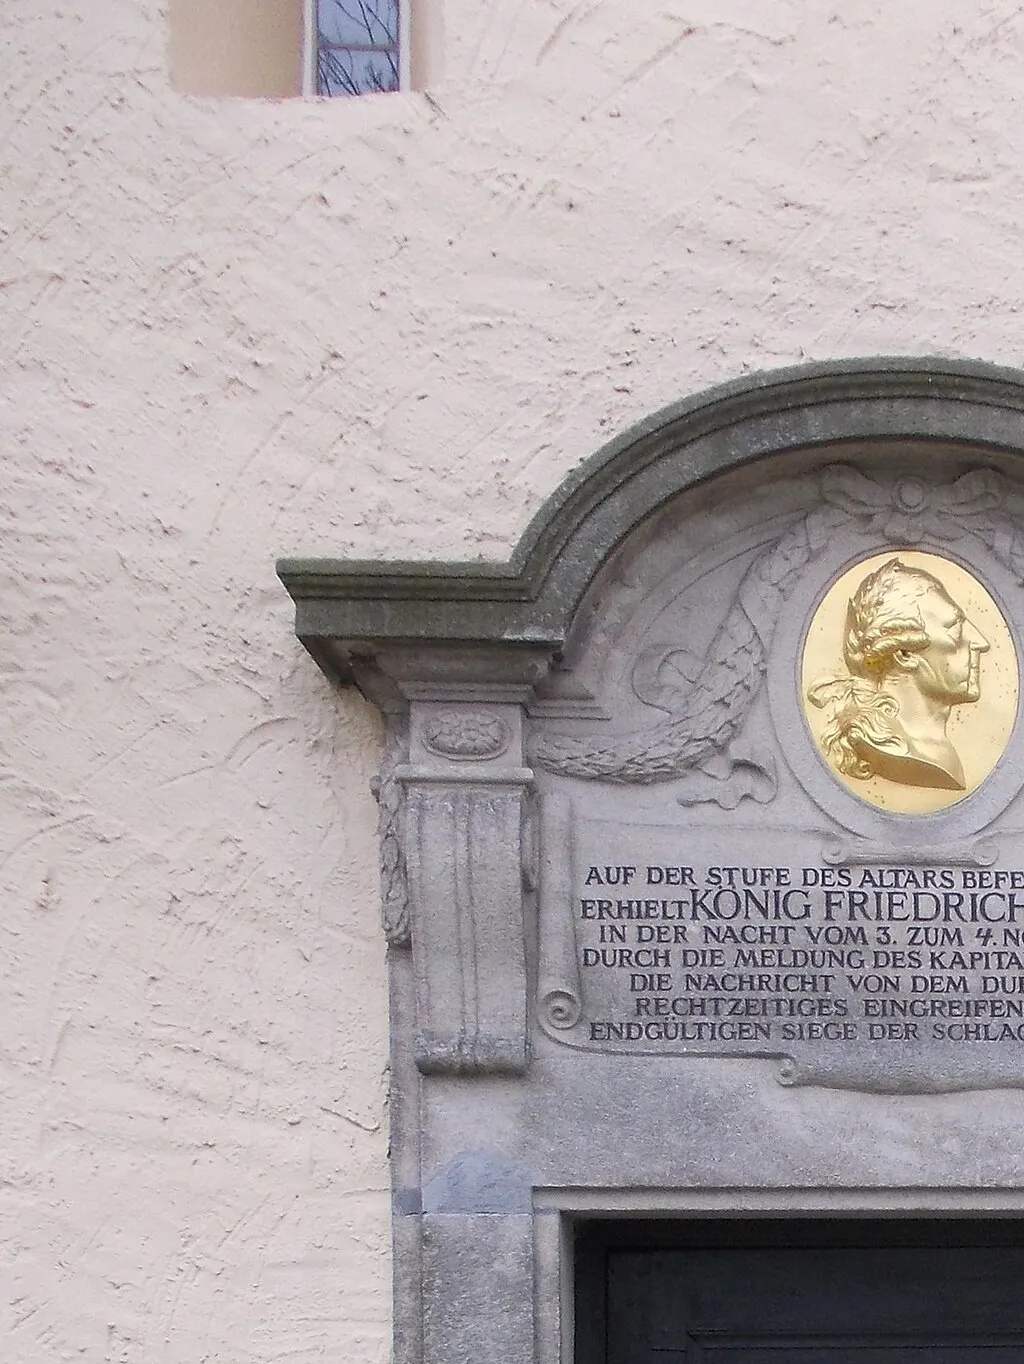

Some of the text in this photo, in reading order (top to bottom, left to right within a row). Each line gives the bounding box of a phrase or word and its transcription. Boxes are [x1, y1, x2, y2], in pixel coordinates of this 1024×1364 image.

[585, 866, 636, 885] AUF
[646, 867, 696, 886] DER
[705, 867, 790, 886] STUFE
[802, 868, 851, 887] DES
[858, 868, 954, 889] ALTARS
[581, 900, 689, 919] ERHIELT
[689, 884, 811, 920] KÖNIG
[599, 925, 627, 943] IN
[636, 926, 689, 943] DER
[703, 926, 793, 945] NACHT
[805, 927, 867, 945] VOM
[876, 927, 897, 945] 3.
[907, 927, 963, 946] ZUM
[975, 929, 997, 947] 4.
[583, 949, 671, 967] DURCH
[682, 949, 725, 967] DIE
[733, 950, 865, 968] MELDUNG
[873, 951, 922, 969] DES
[630, 974, 672, 992] DIE
[684, 974, 835, 992] NACHRICHT
[847, 975, 900, 993] VON
[911, 976, 968, 994] DEM
[635, 998, 847, 1017] RECHTZEITIGES
[864, 999, 1023, 1018] EINGREIFEN
[589, 1016, 771, 1041] ENDGÜLTIGEN
[782, 1023, 857, 1041] SIEGE
[869, 1023, 919, 1041] DER
